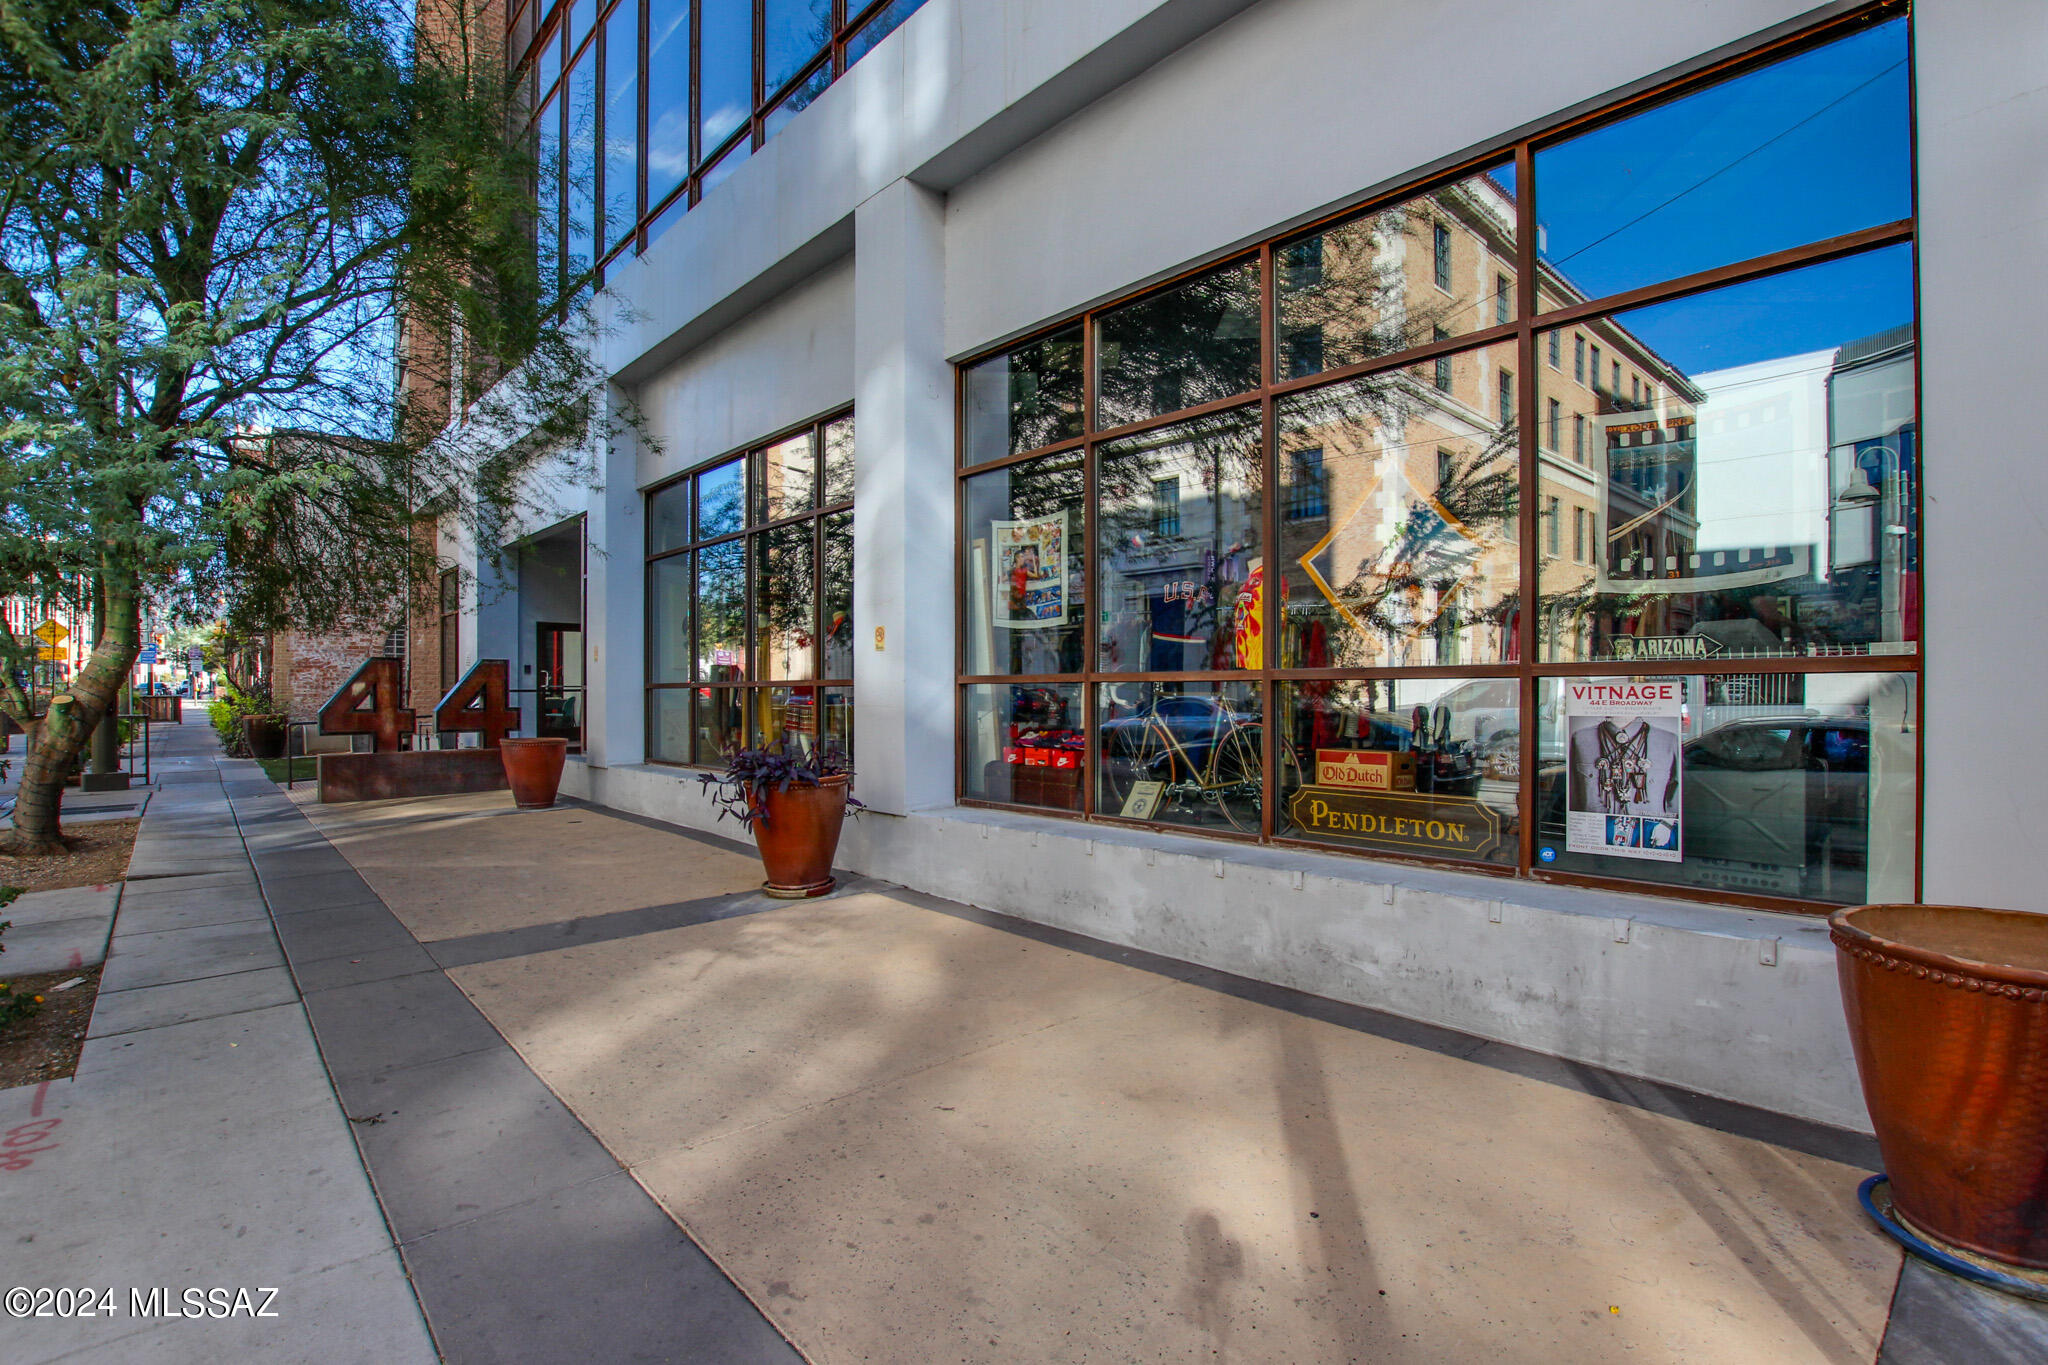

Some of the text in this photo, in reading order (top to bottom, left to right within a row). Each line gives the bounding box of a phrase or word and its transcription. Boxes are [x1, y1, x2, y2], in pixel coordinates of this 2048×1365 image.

[1637, 638, 1706, 656] ARIZONA
[1572, 685, 1673, 700] VITNAGE
[318, 657, 521, 752] 44
[1322, 766, 1345, 782] Old
[1346, 766, 1384, 784] Dutch
[1310, 799, 1467, 842] PENDLETON
